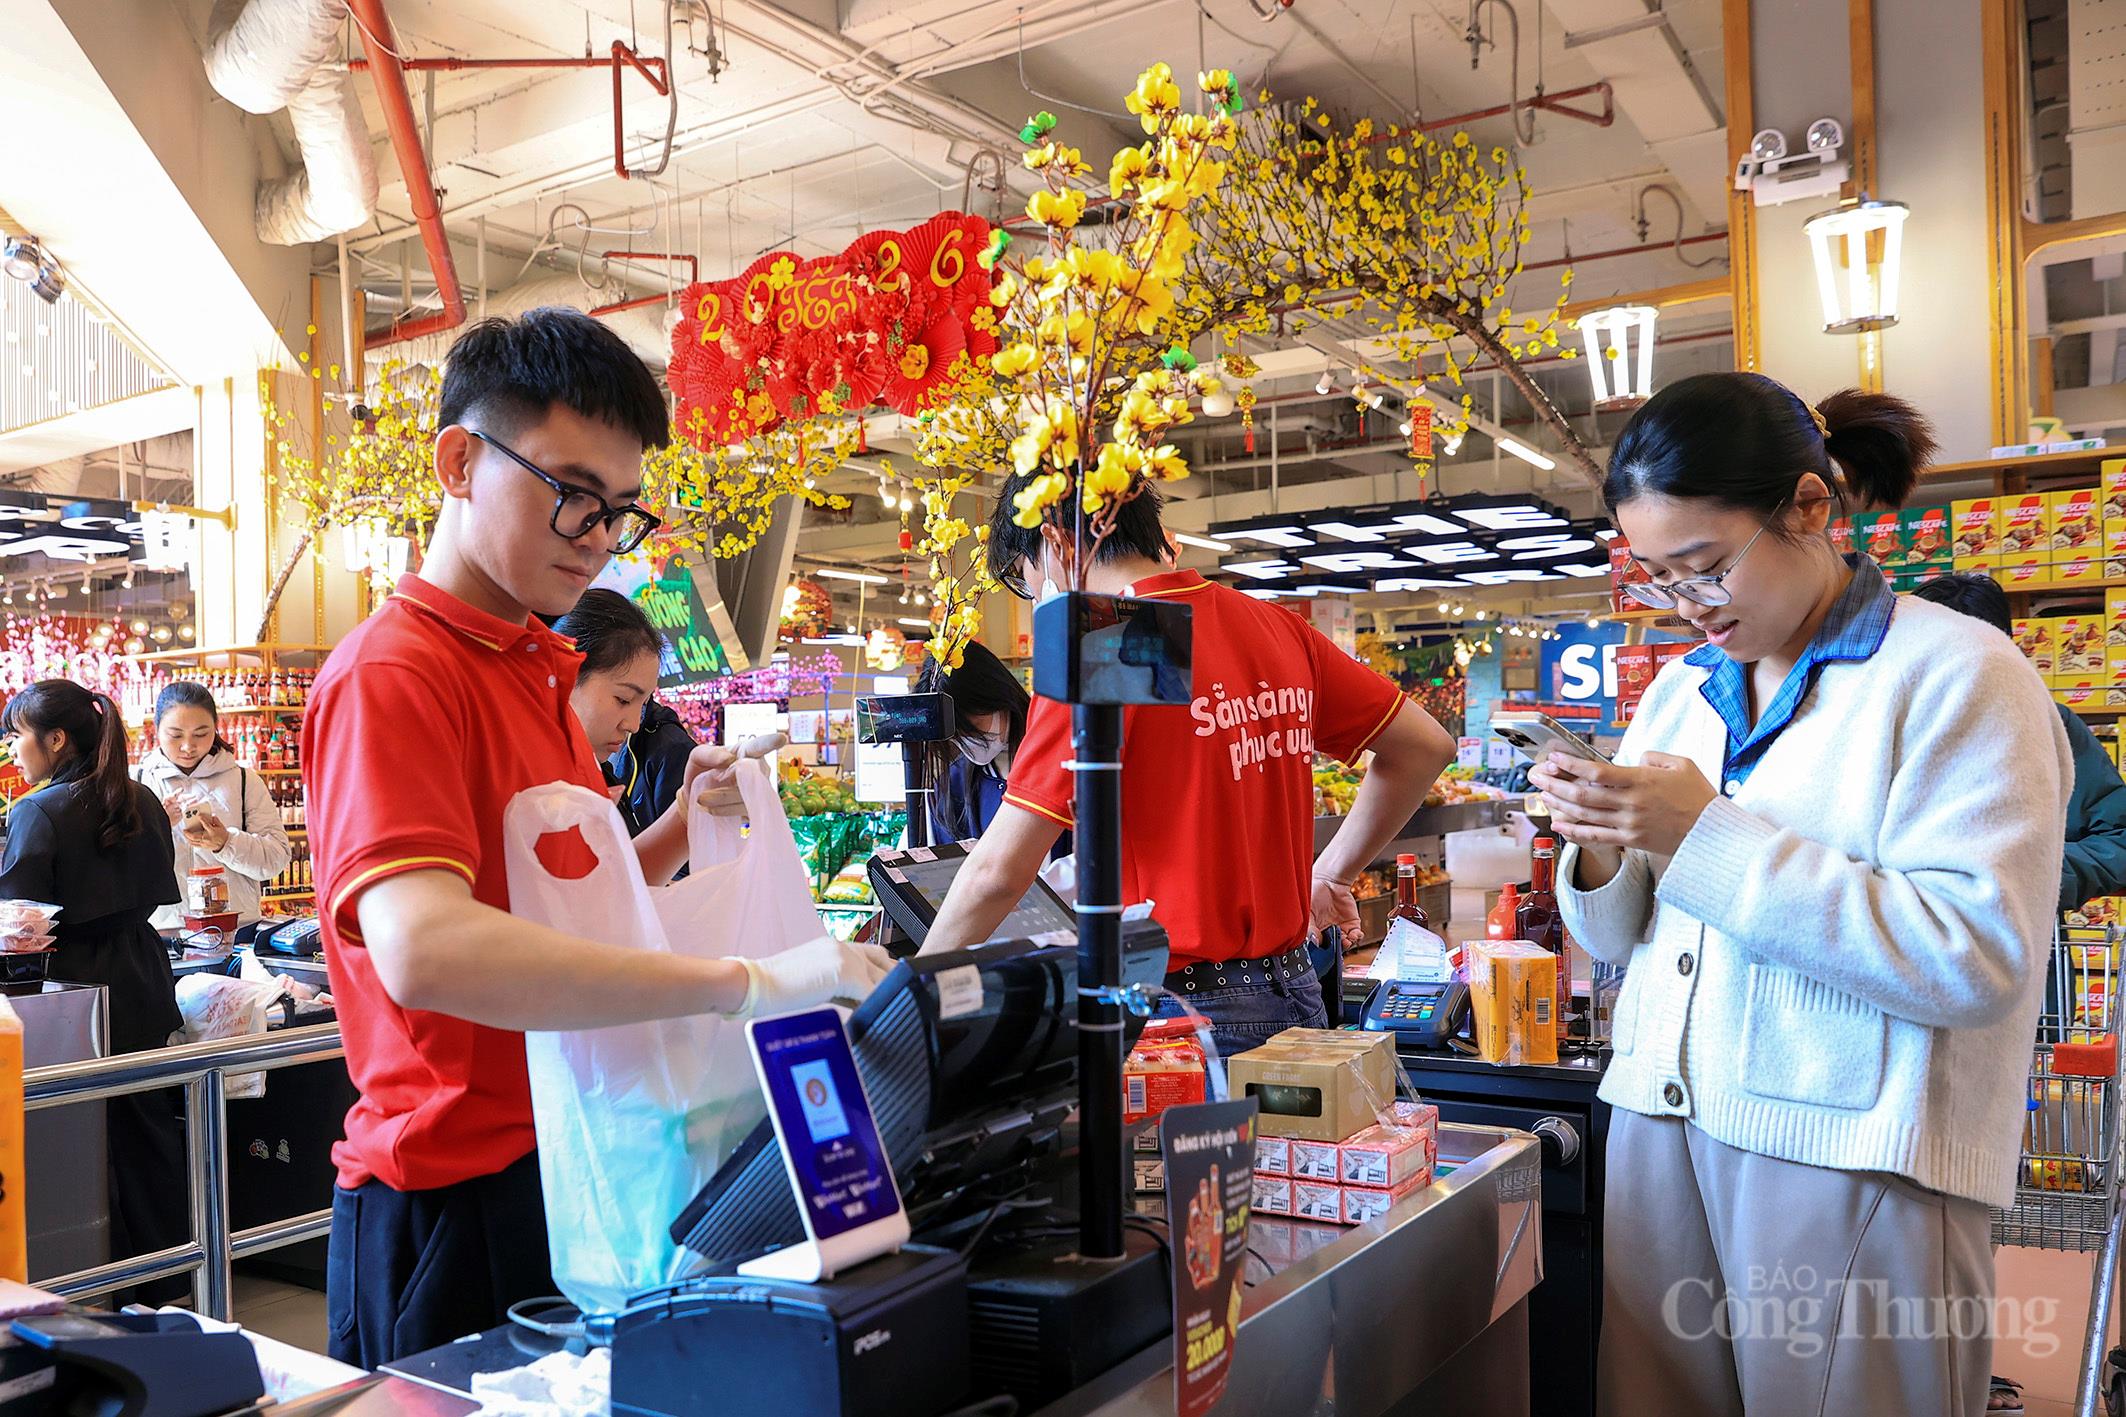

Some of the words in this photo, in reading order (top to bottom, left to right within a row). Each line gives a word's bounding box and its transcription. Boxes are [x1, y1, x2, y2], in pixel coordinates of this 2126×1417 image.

[1219, 529, 1619, 580] FRES
[678, 635, 719, 672] CAO
[1229, 727, 1283, 781] phục
